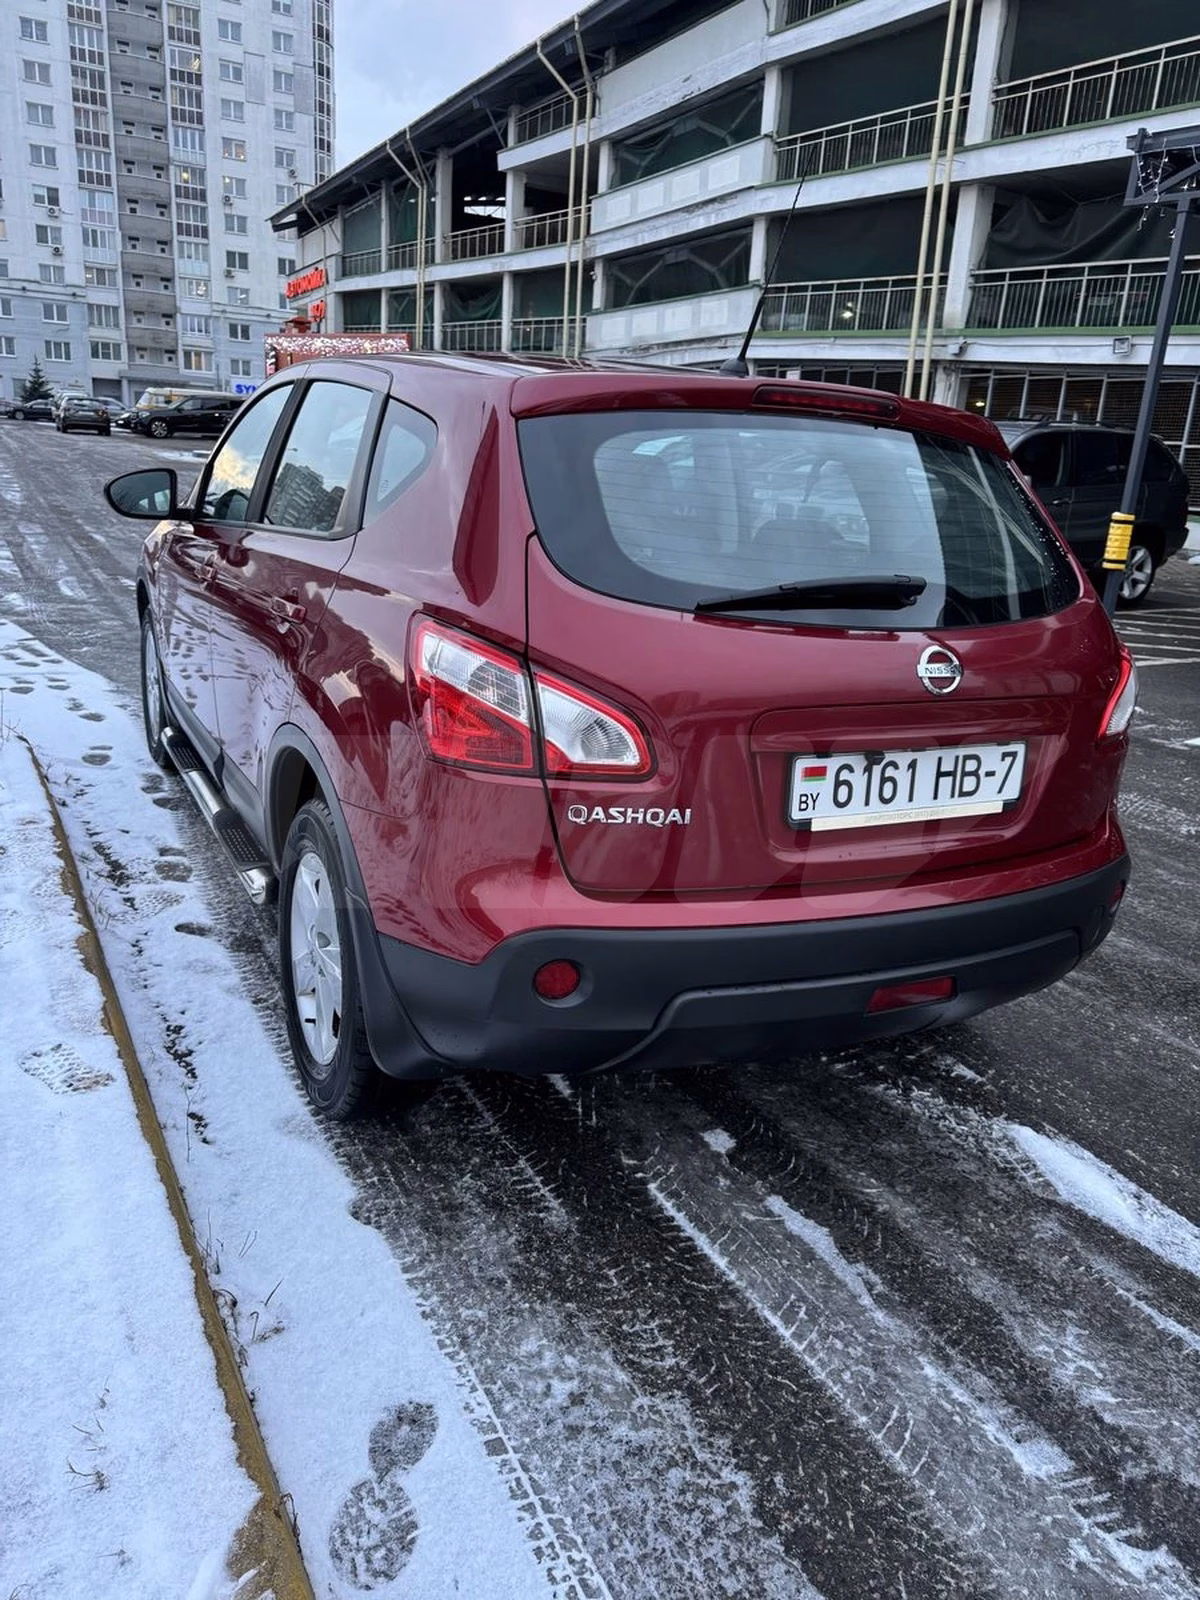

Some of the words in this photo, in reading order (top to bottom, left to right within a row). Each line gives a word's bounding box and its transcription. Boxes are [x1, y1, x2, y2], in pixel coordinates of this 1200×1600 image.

[832, 758, 919, 809] 6161
[932, 750, 1019, 801] HB-7
[798, 793, 820, 812] BY
[567, 804, 692, 828] QASHQAI
